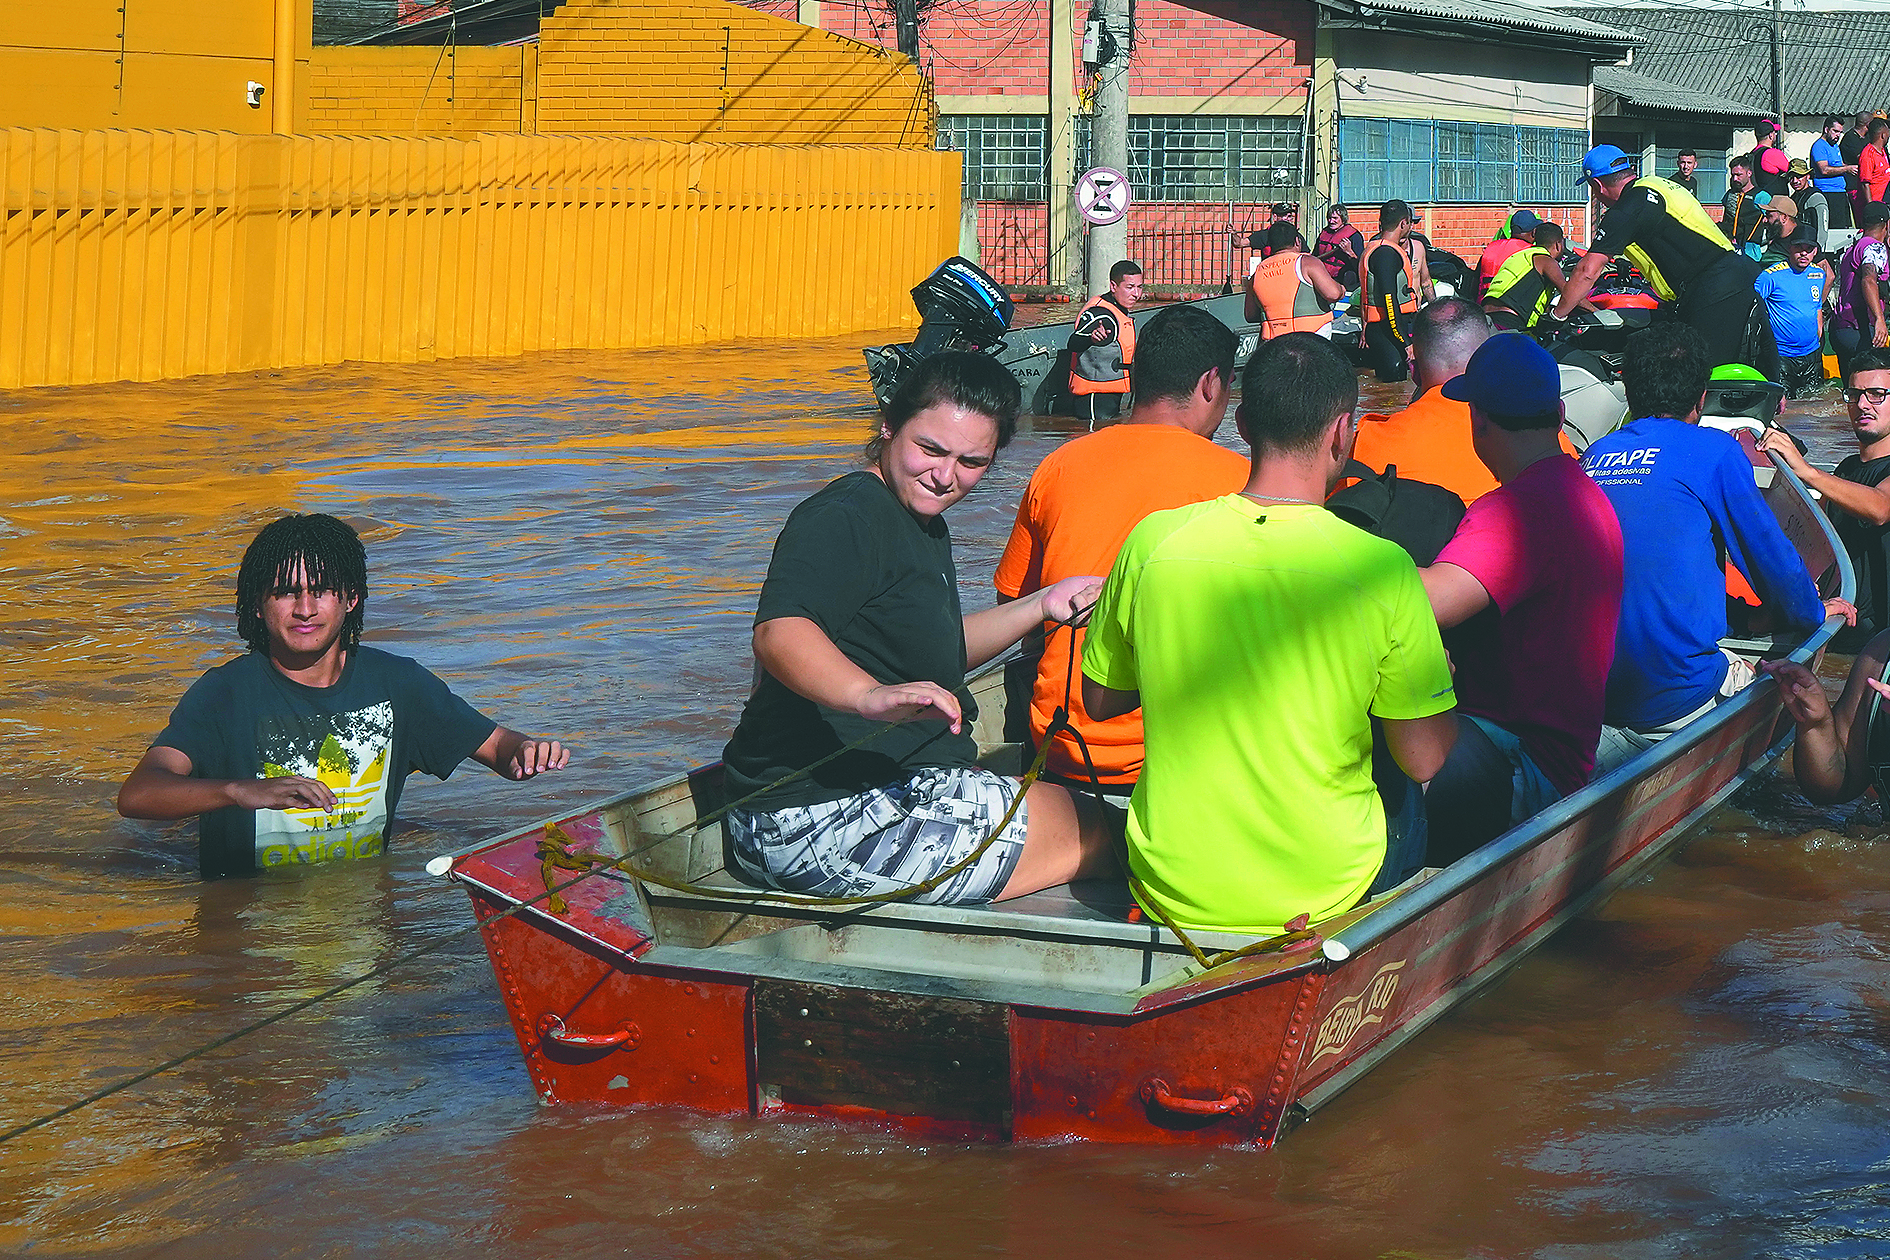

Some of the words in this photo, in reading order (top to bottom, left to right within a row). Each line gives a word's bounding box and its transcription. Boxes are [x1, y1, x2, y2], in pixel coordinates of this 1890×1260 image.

[950, 263, 1005, 303] MERCURY
[1262, 268, 1285, 280] NAVAL
[1311, 999, 1364, 1058] BEIRA
[1364, 973, 1400, 1015] RIO
